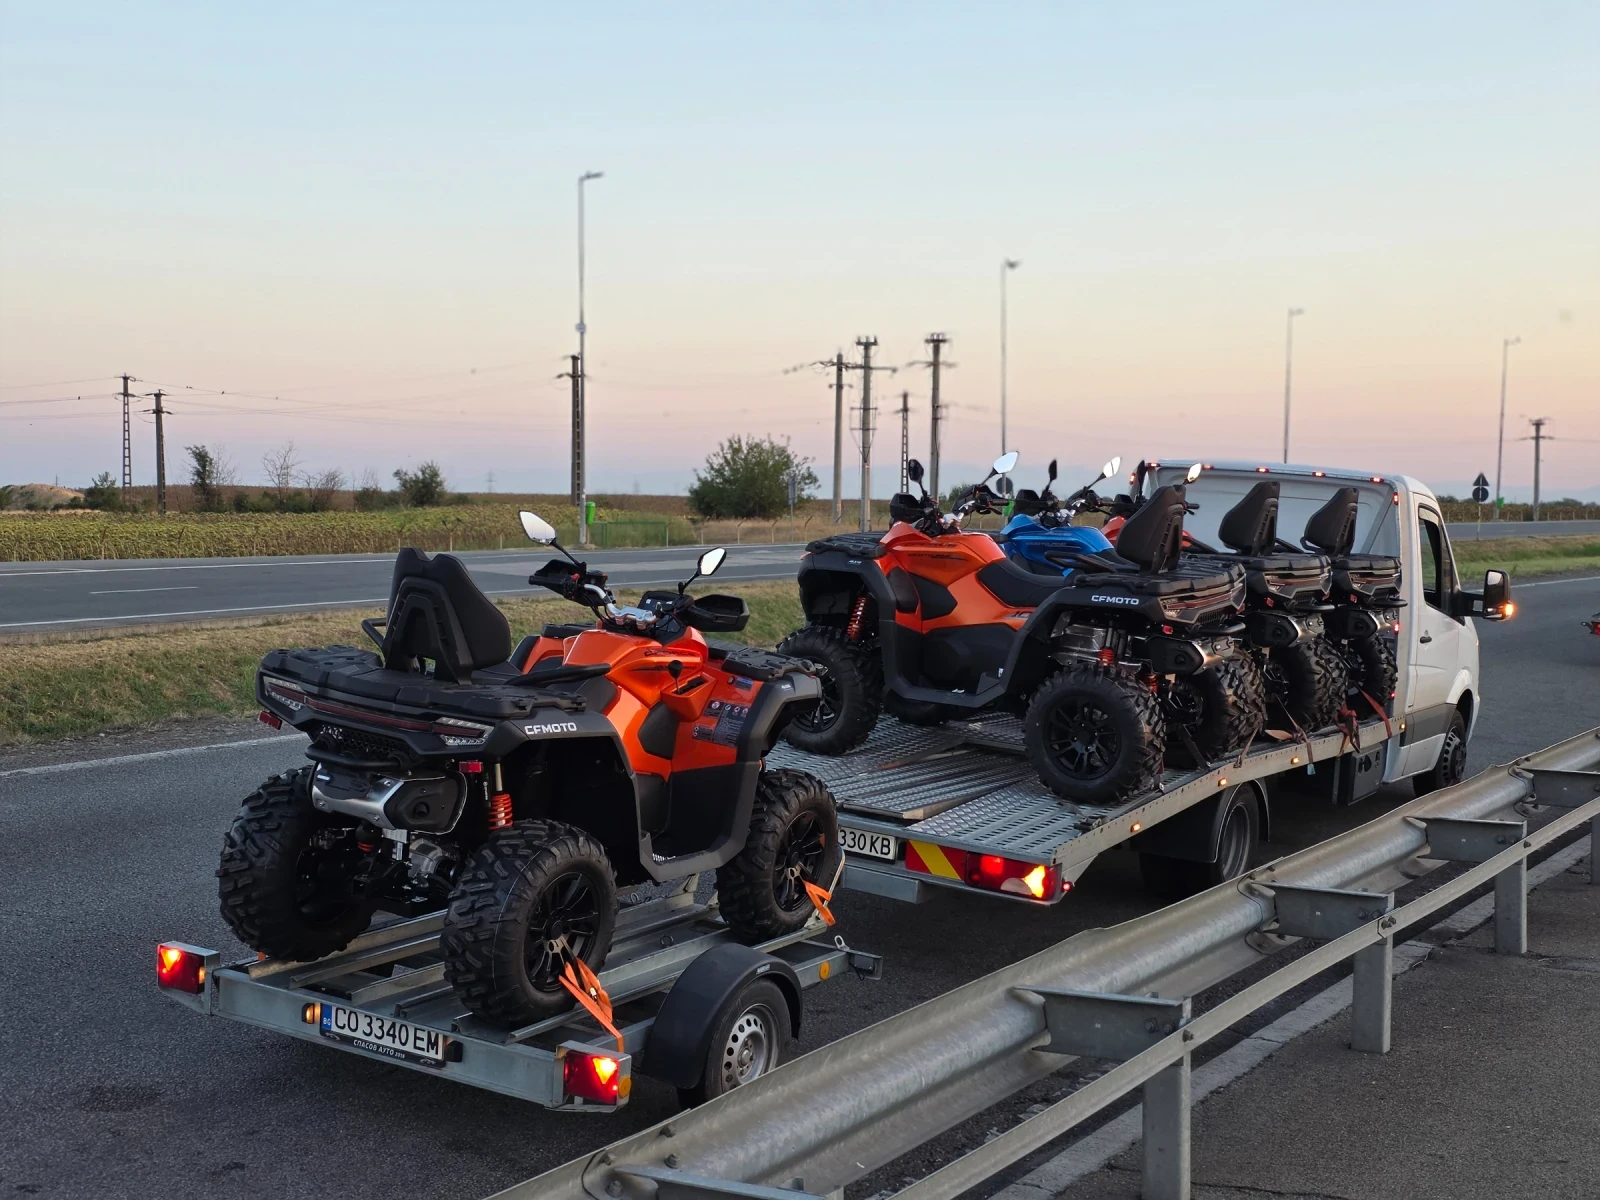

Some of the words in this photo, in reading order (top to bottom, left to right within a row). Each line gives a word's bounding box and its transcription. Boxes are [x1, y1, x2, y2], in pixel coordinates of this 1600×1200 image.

[1091, 595, 1140, 605] CFMOTO
[524, 722, 577, 735] CFMOTO
[869, 836, 891, 856] KB
[322, 1017, 332, 1026] BG
[334, 1007, 359, 1033] CO
[362, 1015, 410, 1047] 3340
[413, 1027, 439, 1056] EM
